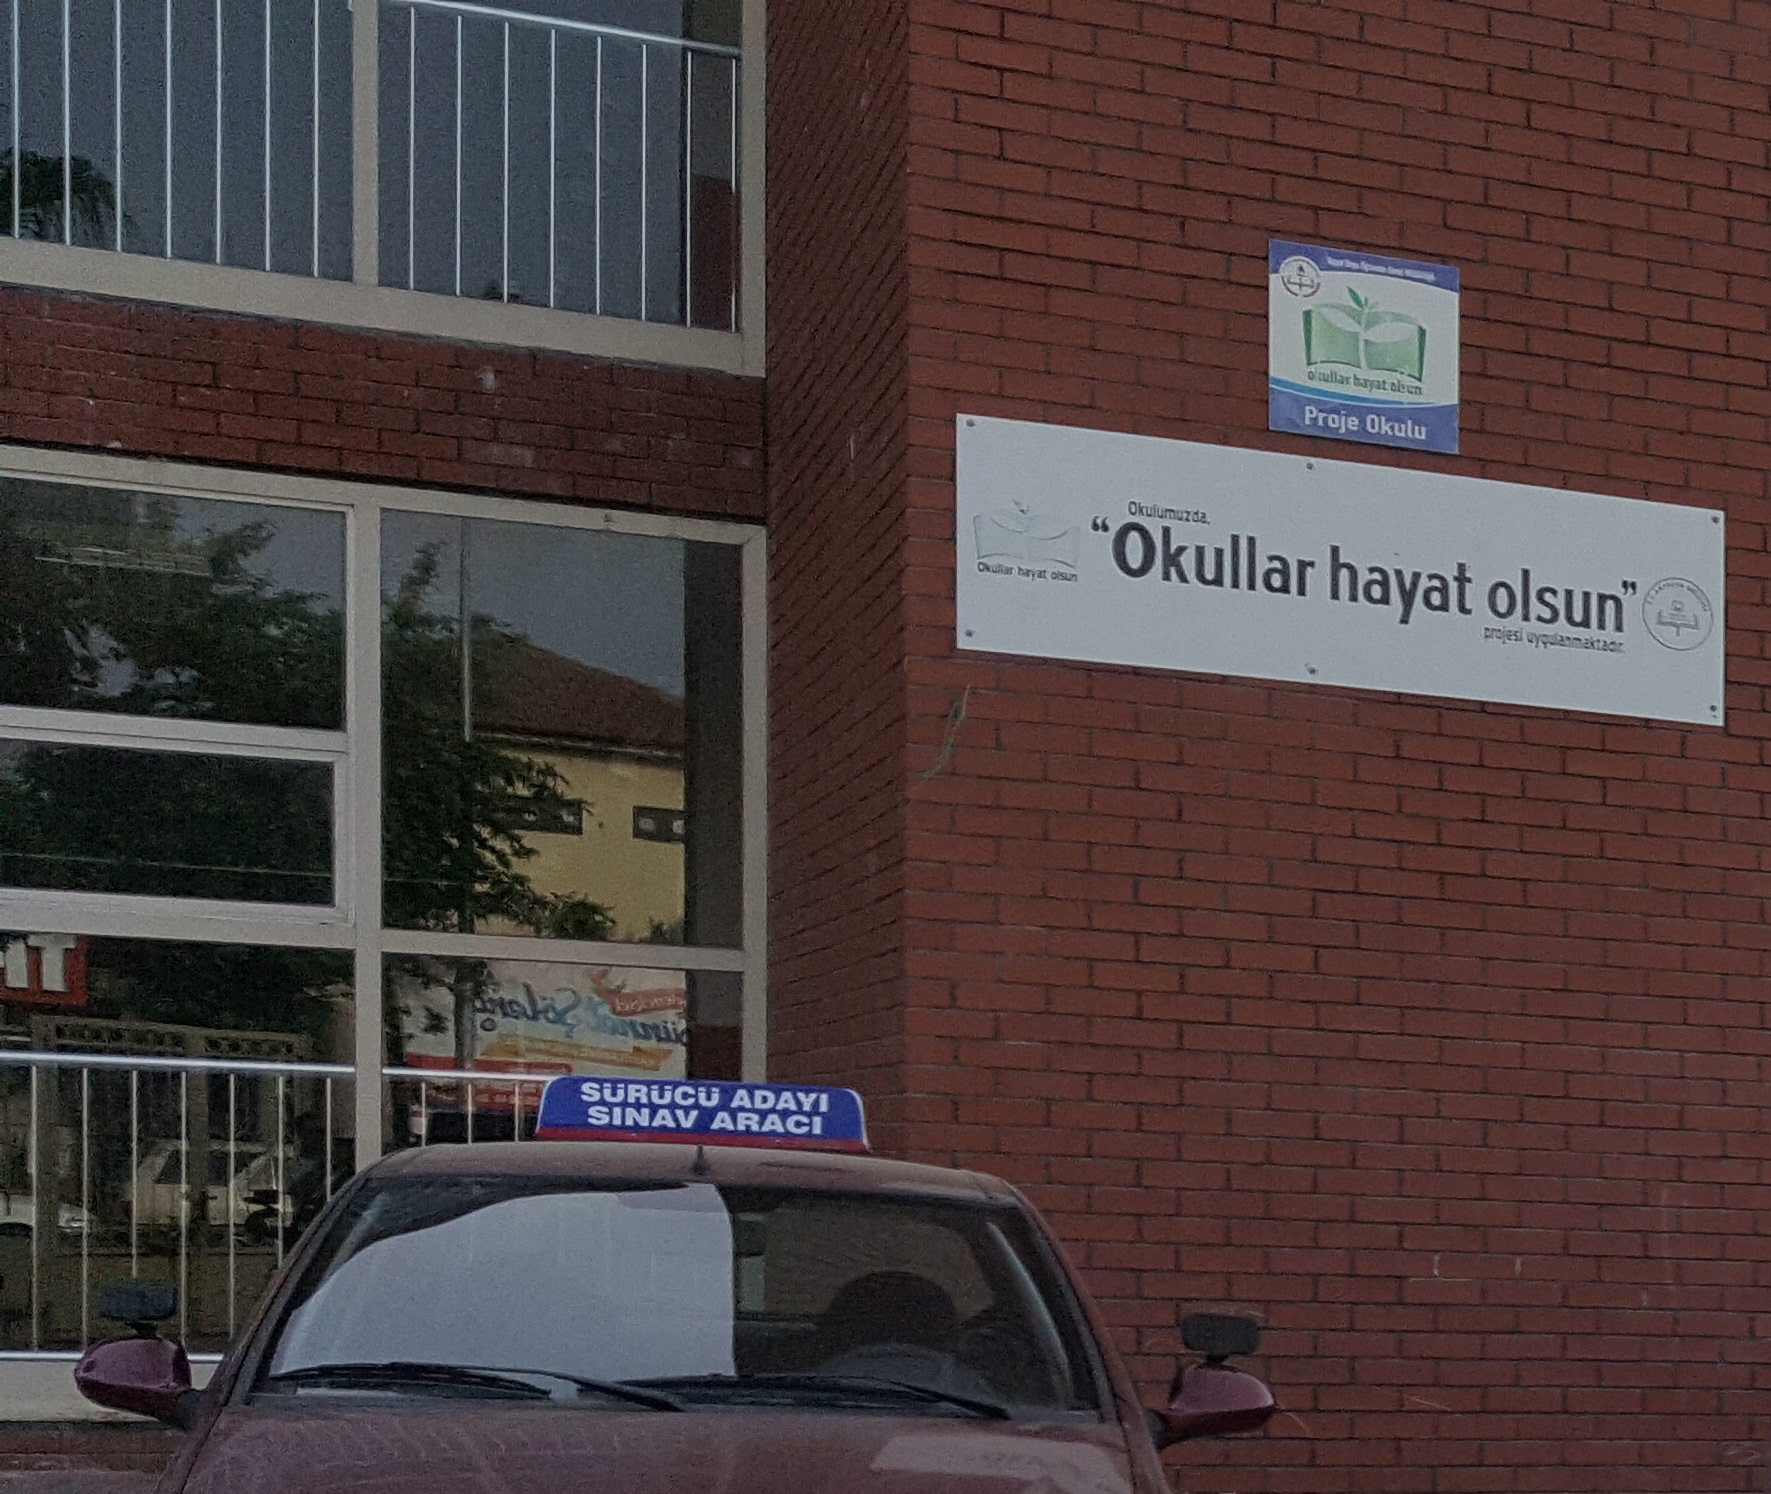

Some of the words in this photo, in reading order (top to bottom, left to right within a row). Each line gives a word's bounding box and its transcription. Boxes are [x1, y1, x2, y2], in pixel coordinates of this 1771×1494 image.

[1304, 405, 1360, 434] Proje
[1365, 414, 1428, 441] Okulu
[1328, 544, 1474, 626] hayat
[580, 1081, 720, 1107] SÜRÜCÜ
[729, 1088, 830, 1113] ADAYI
[586, 1106, 699, 1129] SINAV
[710, 1112, 823, 1135] ARACI
